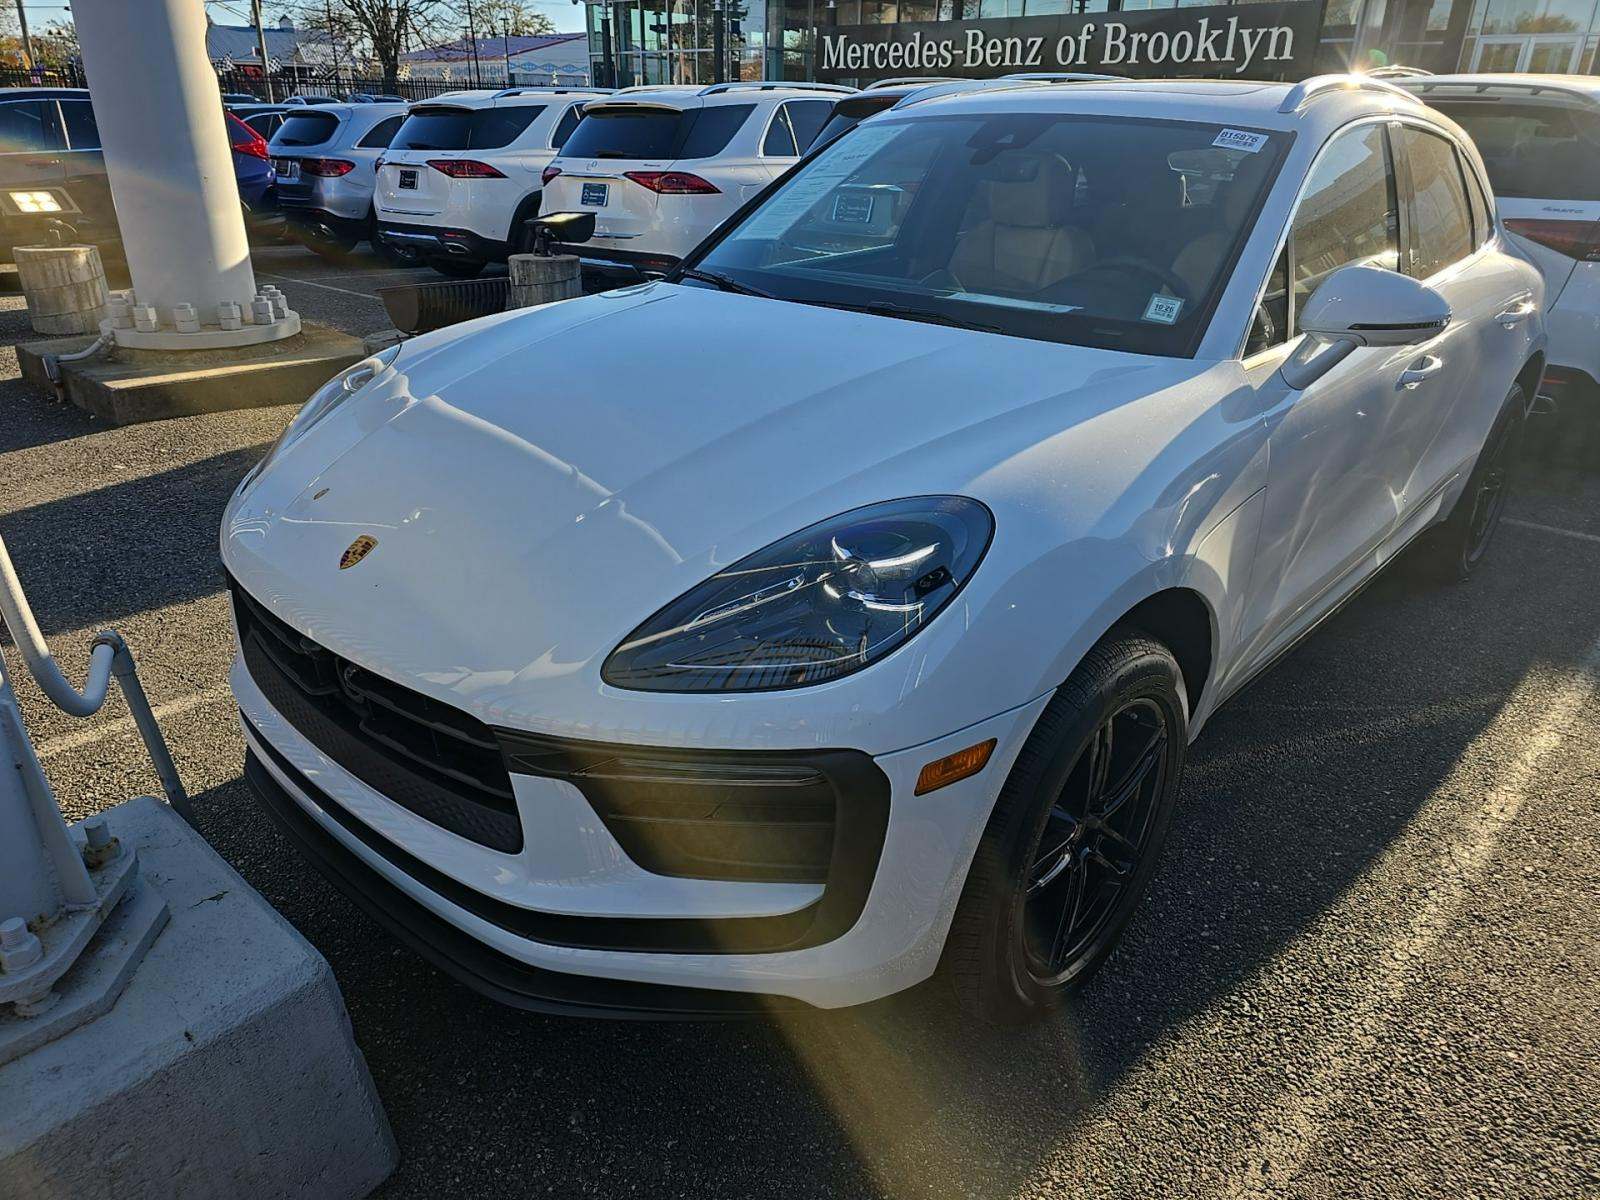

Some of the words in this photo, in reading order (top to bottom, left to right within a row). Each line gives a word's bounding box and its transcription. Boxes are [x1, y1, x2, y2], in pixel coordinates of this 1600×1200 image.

[822, 29, 1044, 69] Mercedes-Benz
[1056, 22, 1096, 65] of
[1100, 16, 1294, 73] Brooklyn
